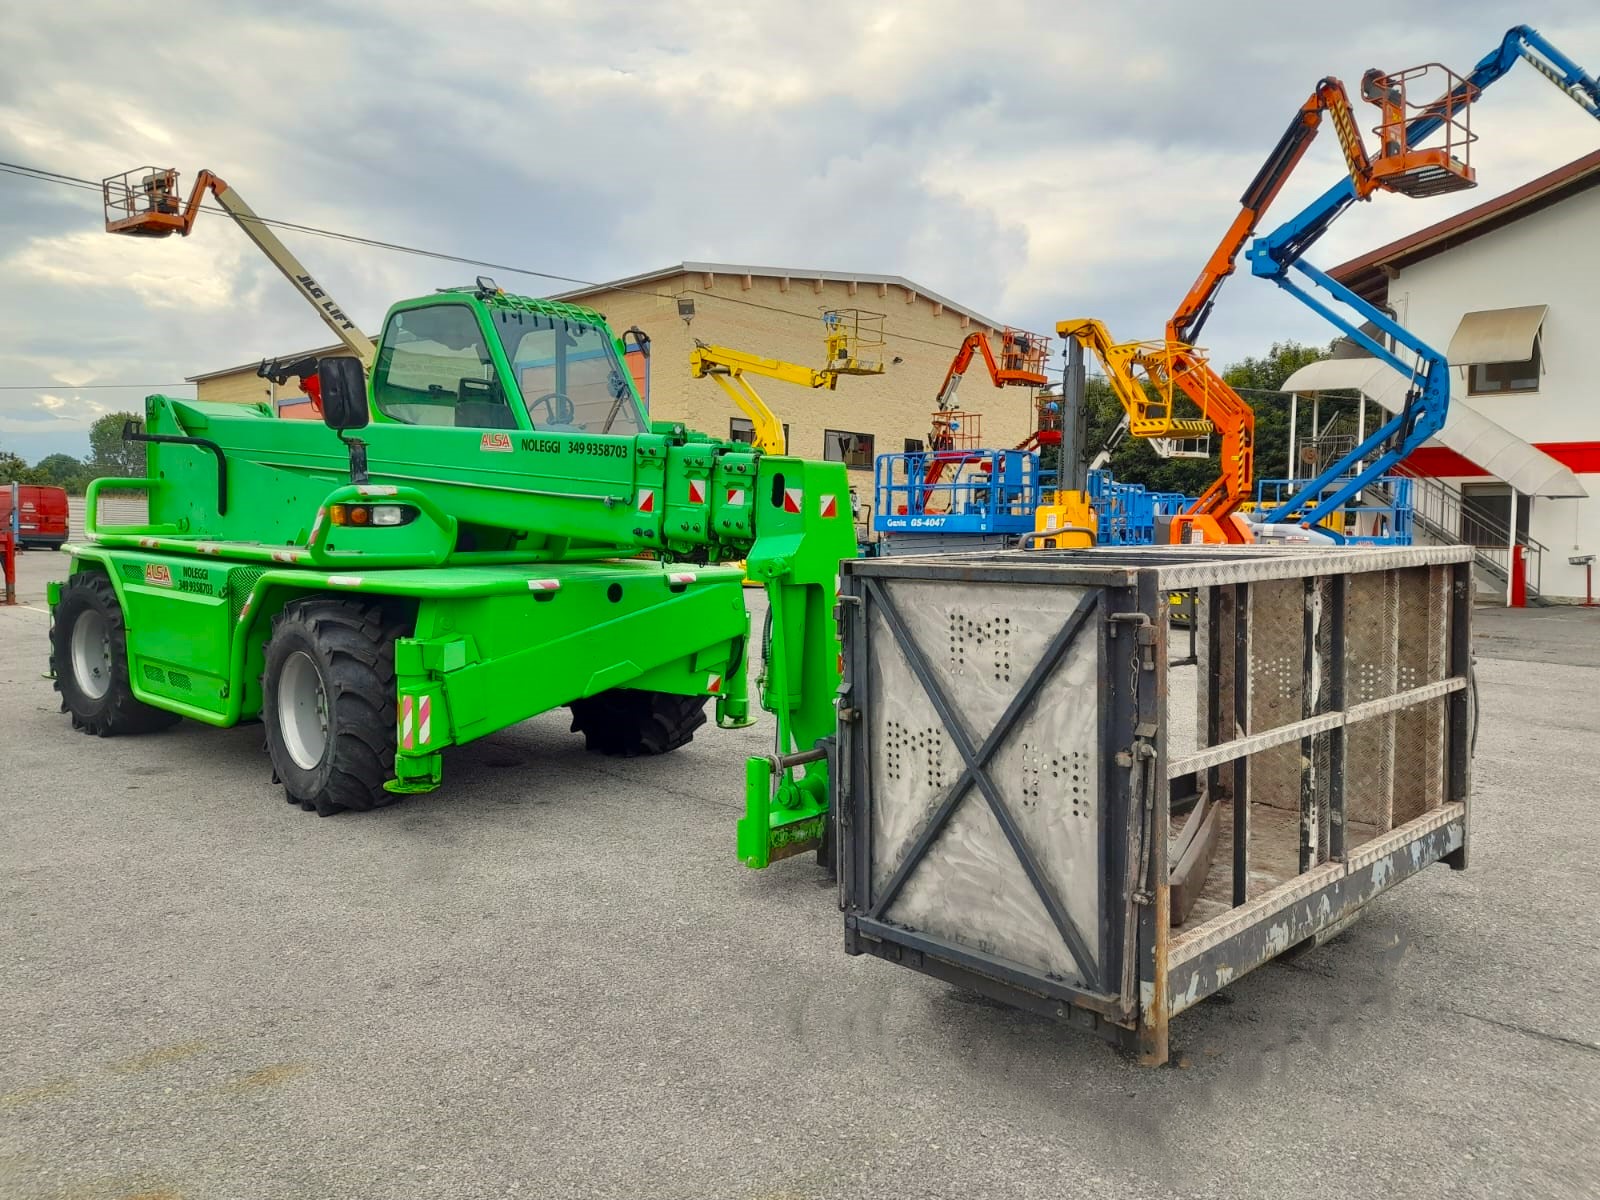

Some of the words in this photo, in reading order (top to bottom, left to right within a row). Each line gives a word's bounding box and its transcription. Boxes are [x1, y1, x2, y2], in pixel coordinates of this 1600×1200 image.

[296, 275, 325, 299] JLG
[322, 301, 355, 330] LIFT
[482, 434, 510, 447] ALSA
[521, 439, 561, 454] NOLEGGI
[886, 518, 907, 527] Genie
[910, 517, 946, 527] GS-4047
[146, 564, 170, 581] ALSA
[183, 566, 209, 580] NOLEGGI
